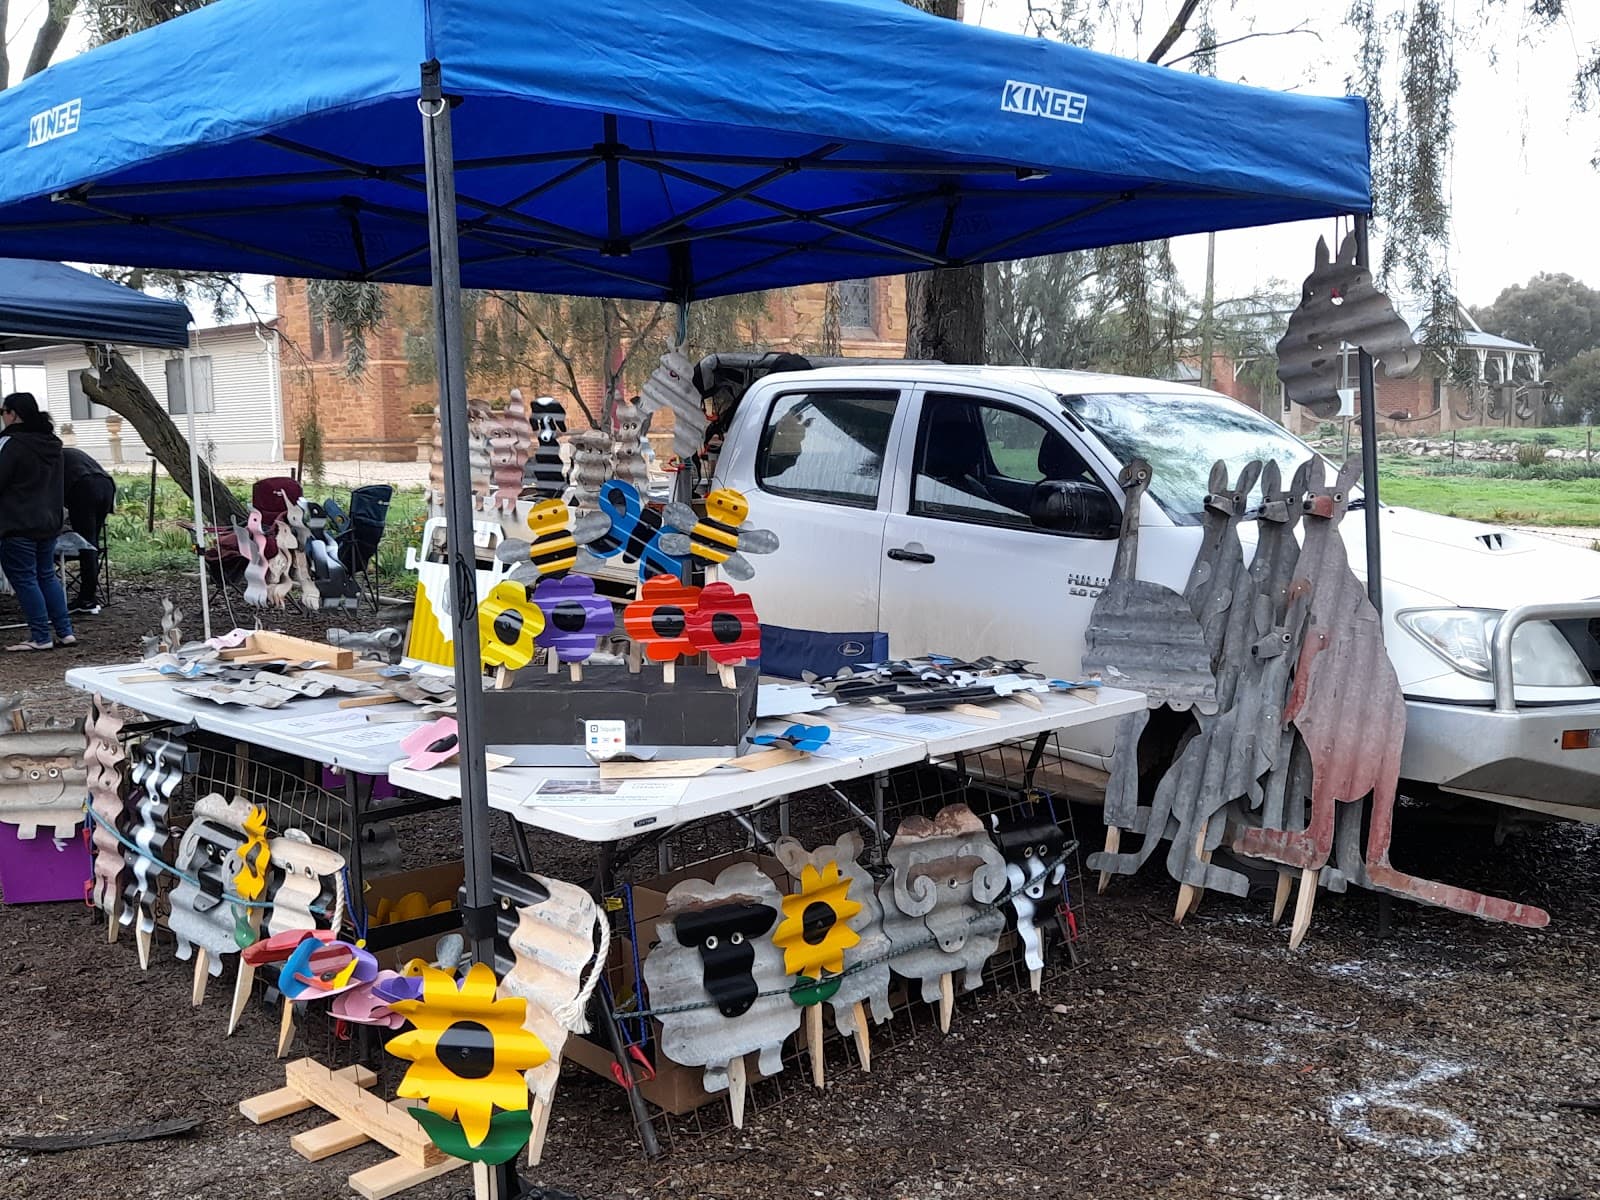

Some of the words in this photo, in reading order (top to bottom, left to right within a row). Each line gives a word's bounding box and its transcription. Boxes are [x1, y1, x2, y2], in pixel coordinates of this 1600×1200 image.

[1003, 83, 1086, 121] KINGS
[30, 101, 80, 145] KINGS
[1067, 573, 1112, 589] HILU
